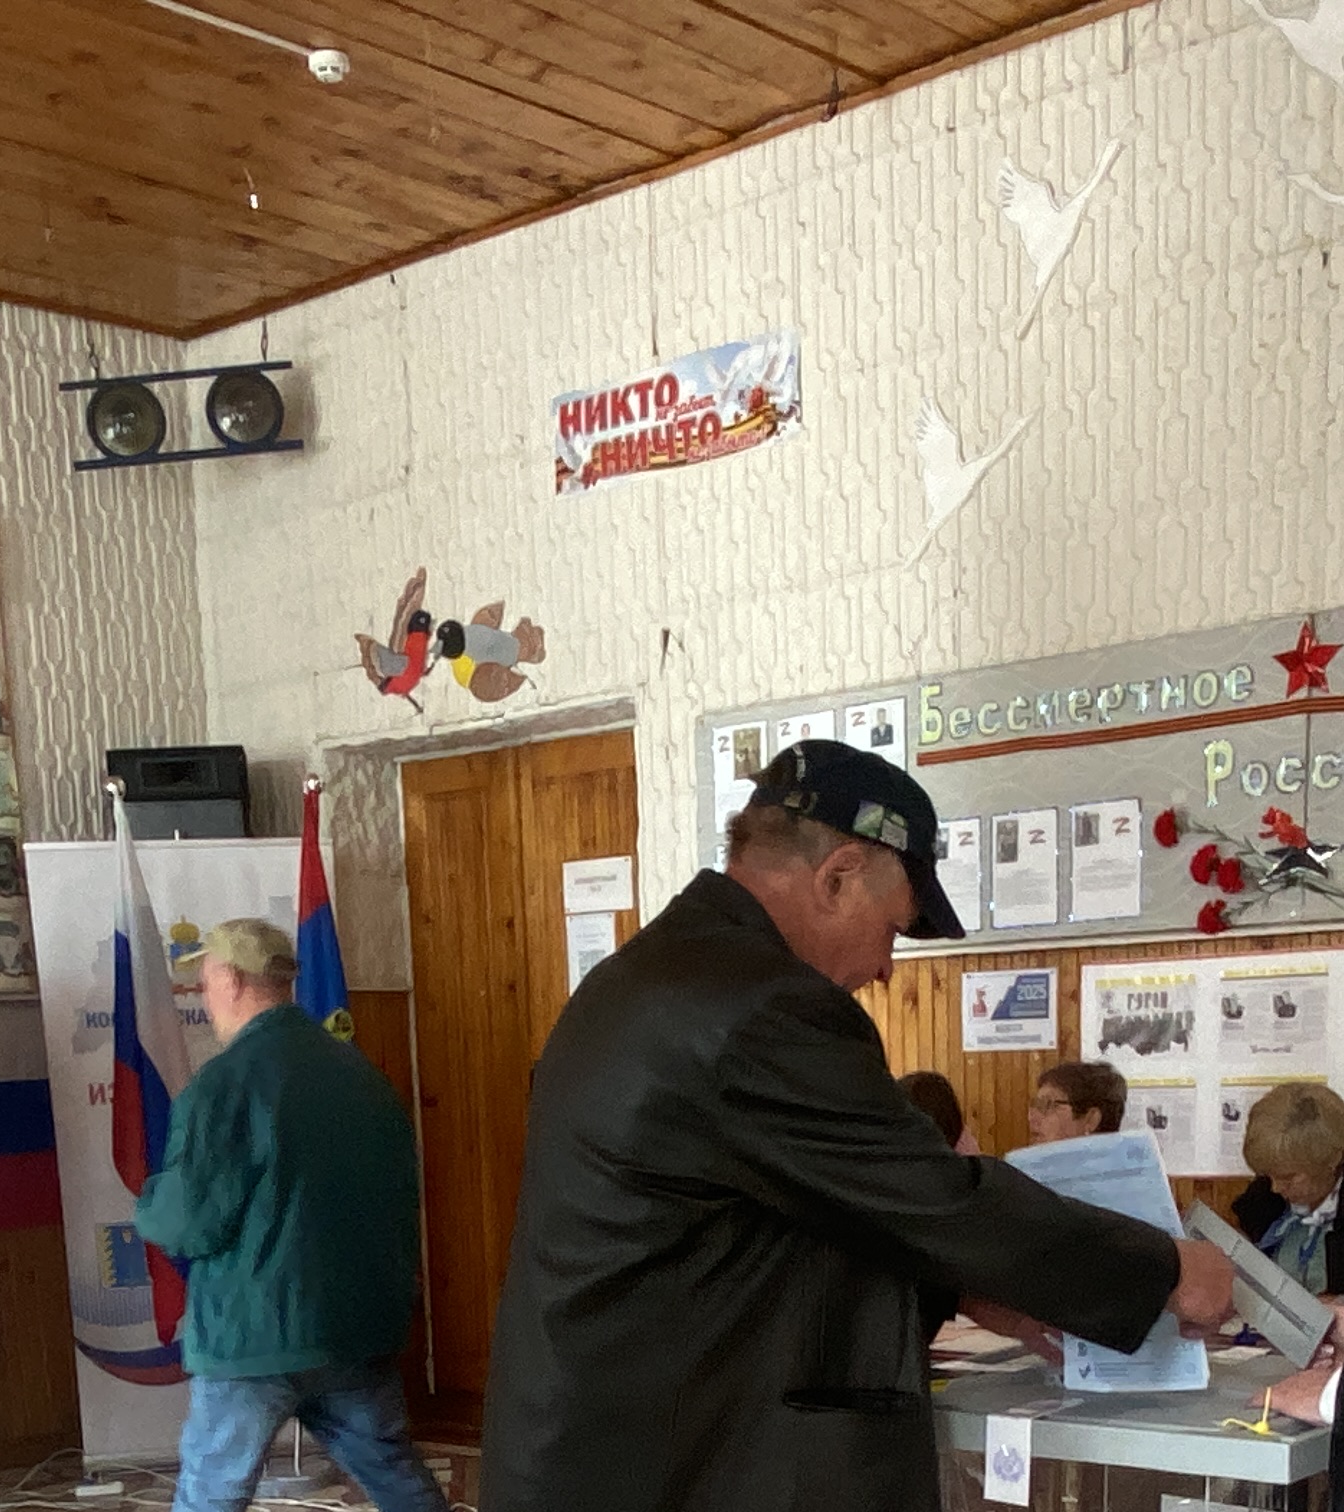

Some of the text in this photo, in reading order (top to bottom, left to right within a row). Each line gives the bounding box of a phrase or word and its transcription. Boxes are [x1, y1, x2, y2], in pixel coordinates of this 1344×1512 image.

[559, 373, 680, 440] НИКТО
[599, 411, 722, 480] НИЧТО
[917, 664, 1255, 746] Бессмертное
